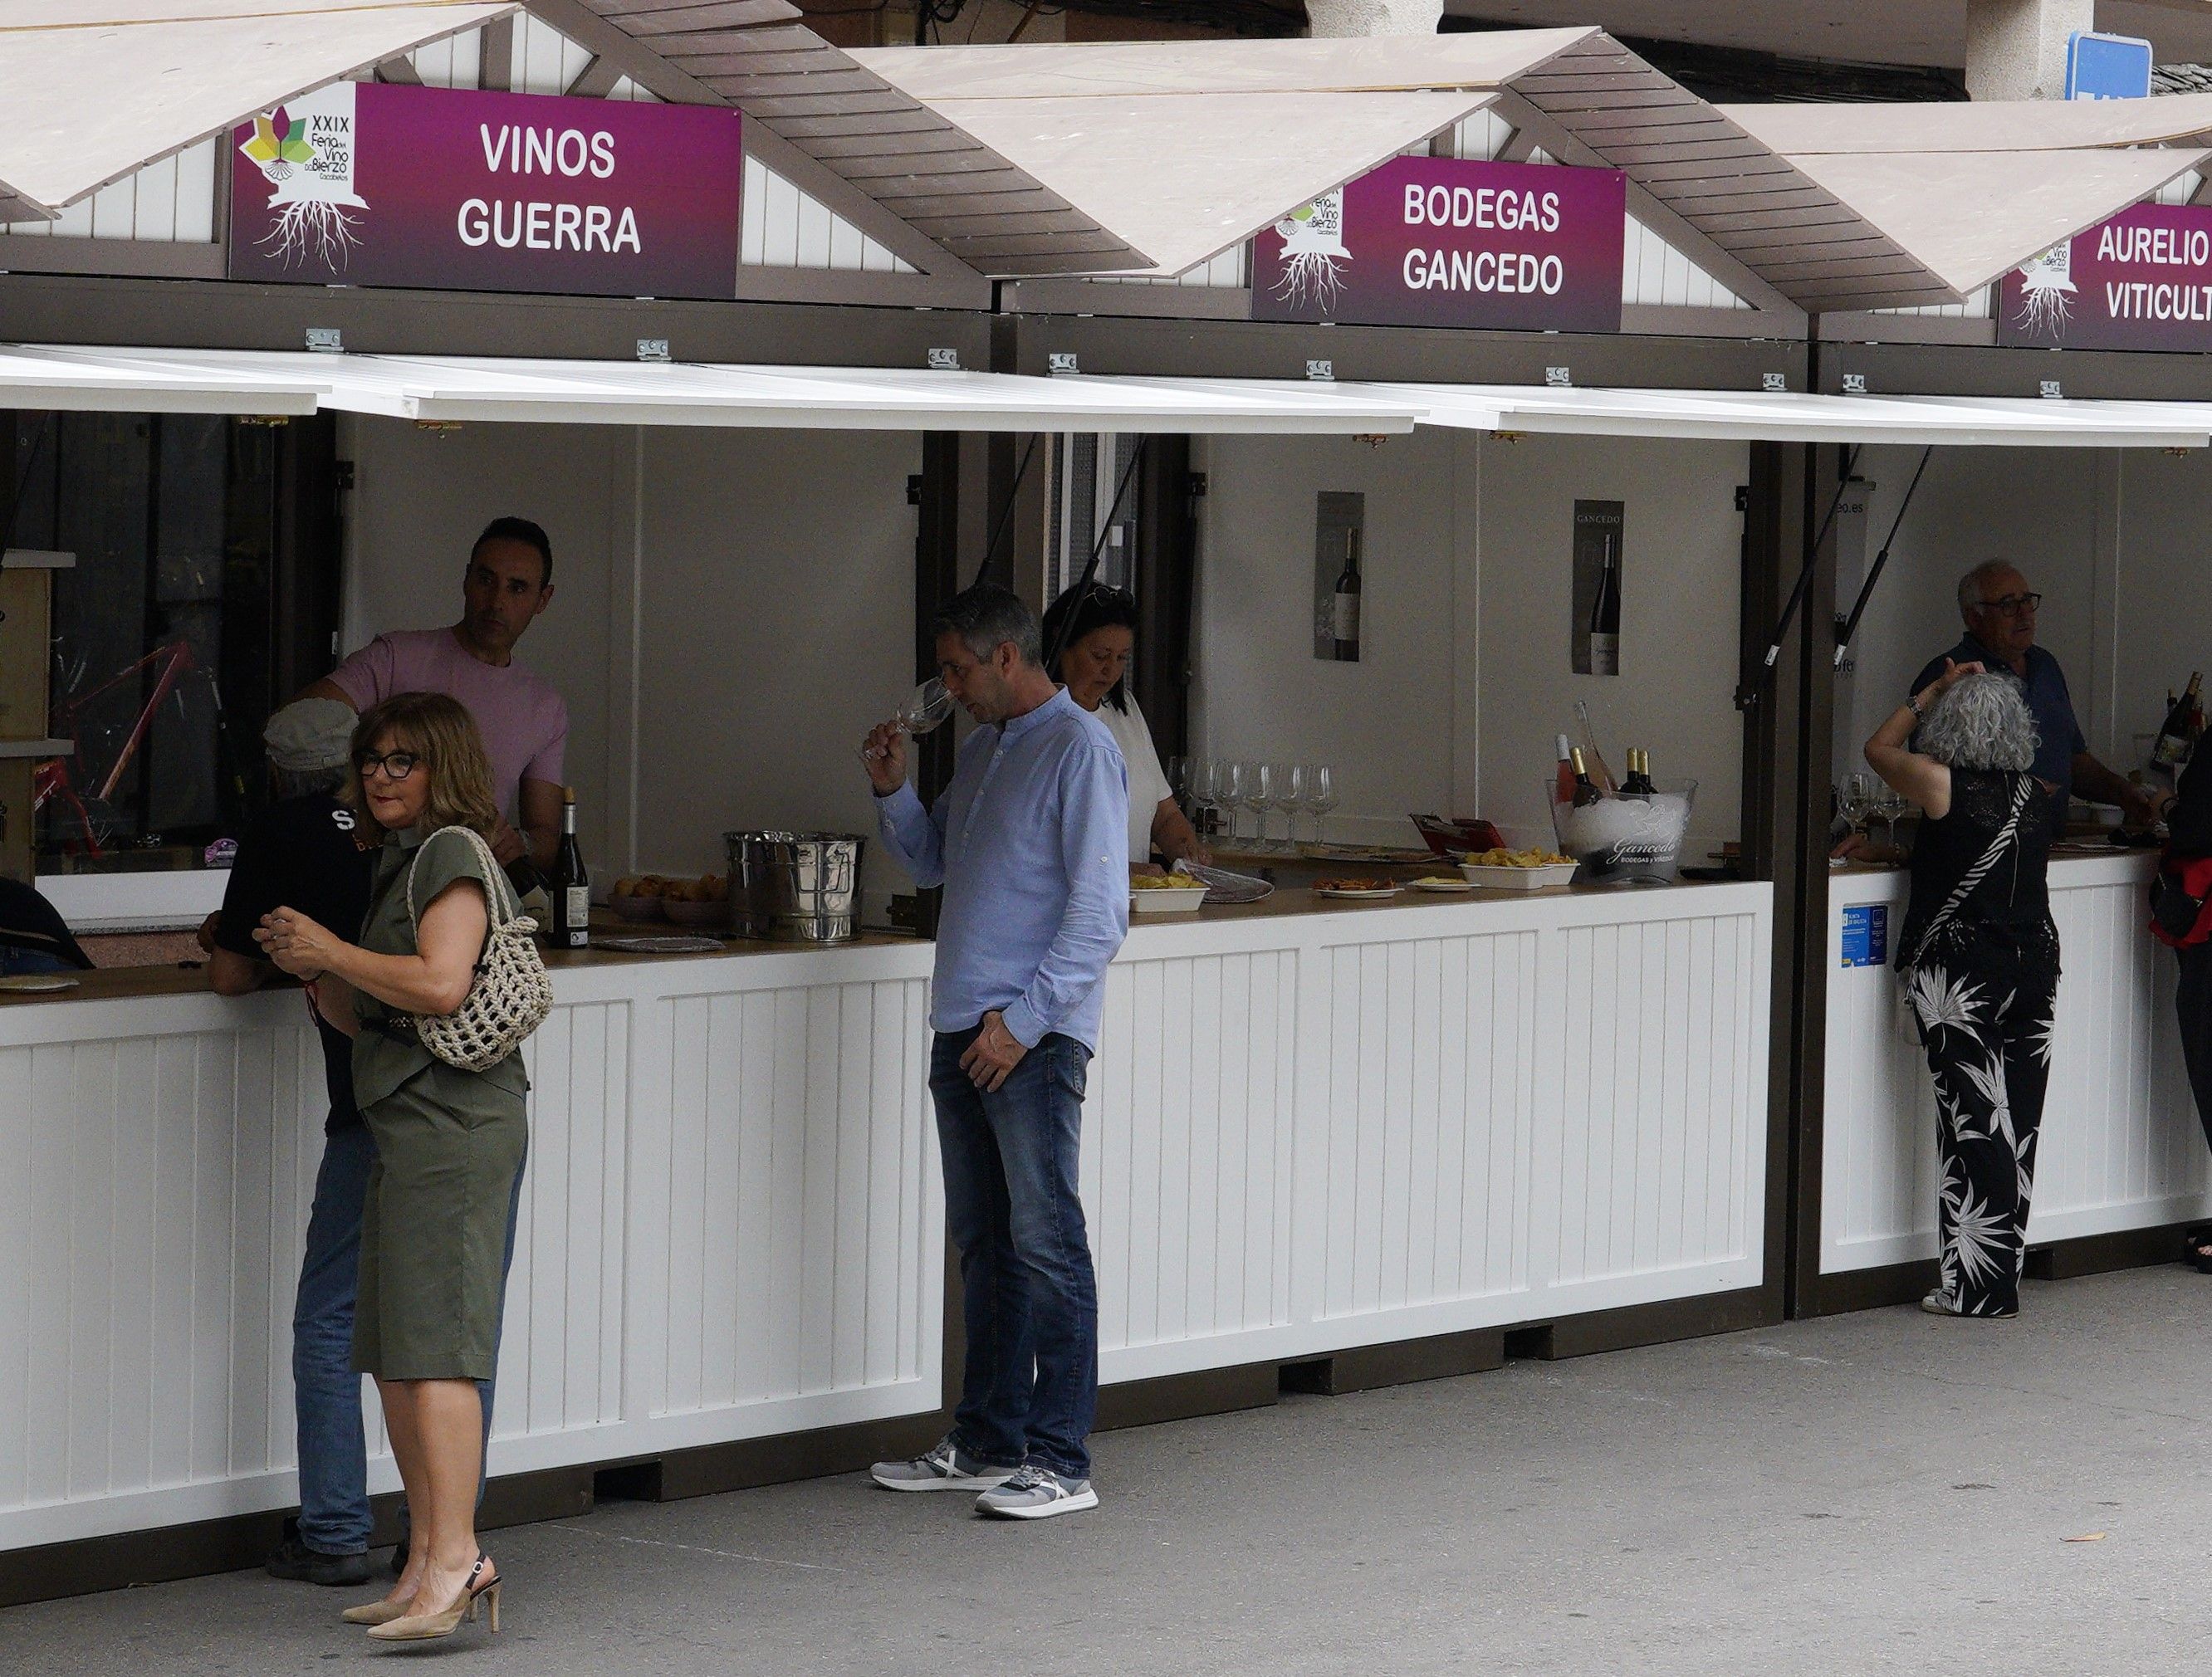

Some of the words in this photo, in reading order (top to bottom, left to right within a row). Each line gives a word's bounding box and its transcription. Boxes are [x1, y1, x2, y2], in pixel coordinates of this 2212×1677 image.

[312, 115, 349, 133] XXIX
[324, 147, 349, 163] Vino
[480, 123, 615, 178] VINOS
[458, 198, 641, 254] GUERRA
[1404, 183, 1559, 232] BODEGAS
[2097, 225, 2210, 266] AURELIO
[1403, 247, 1563, 295] GANCEDO
[1606, 836, 1676, 865] Gancedo
